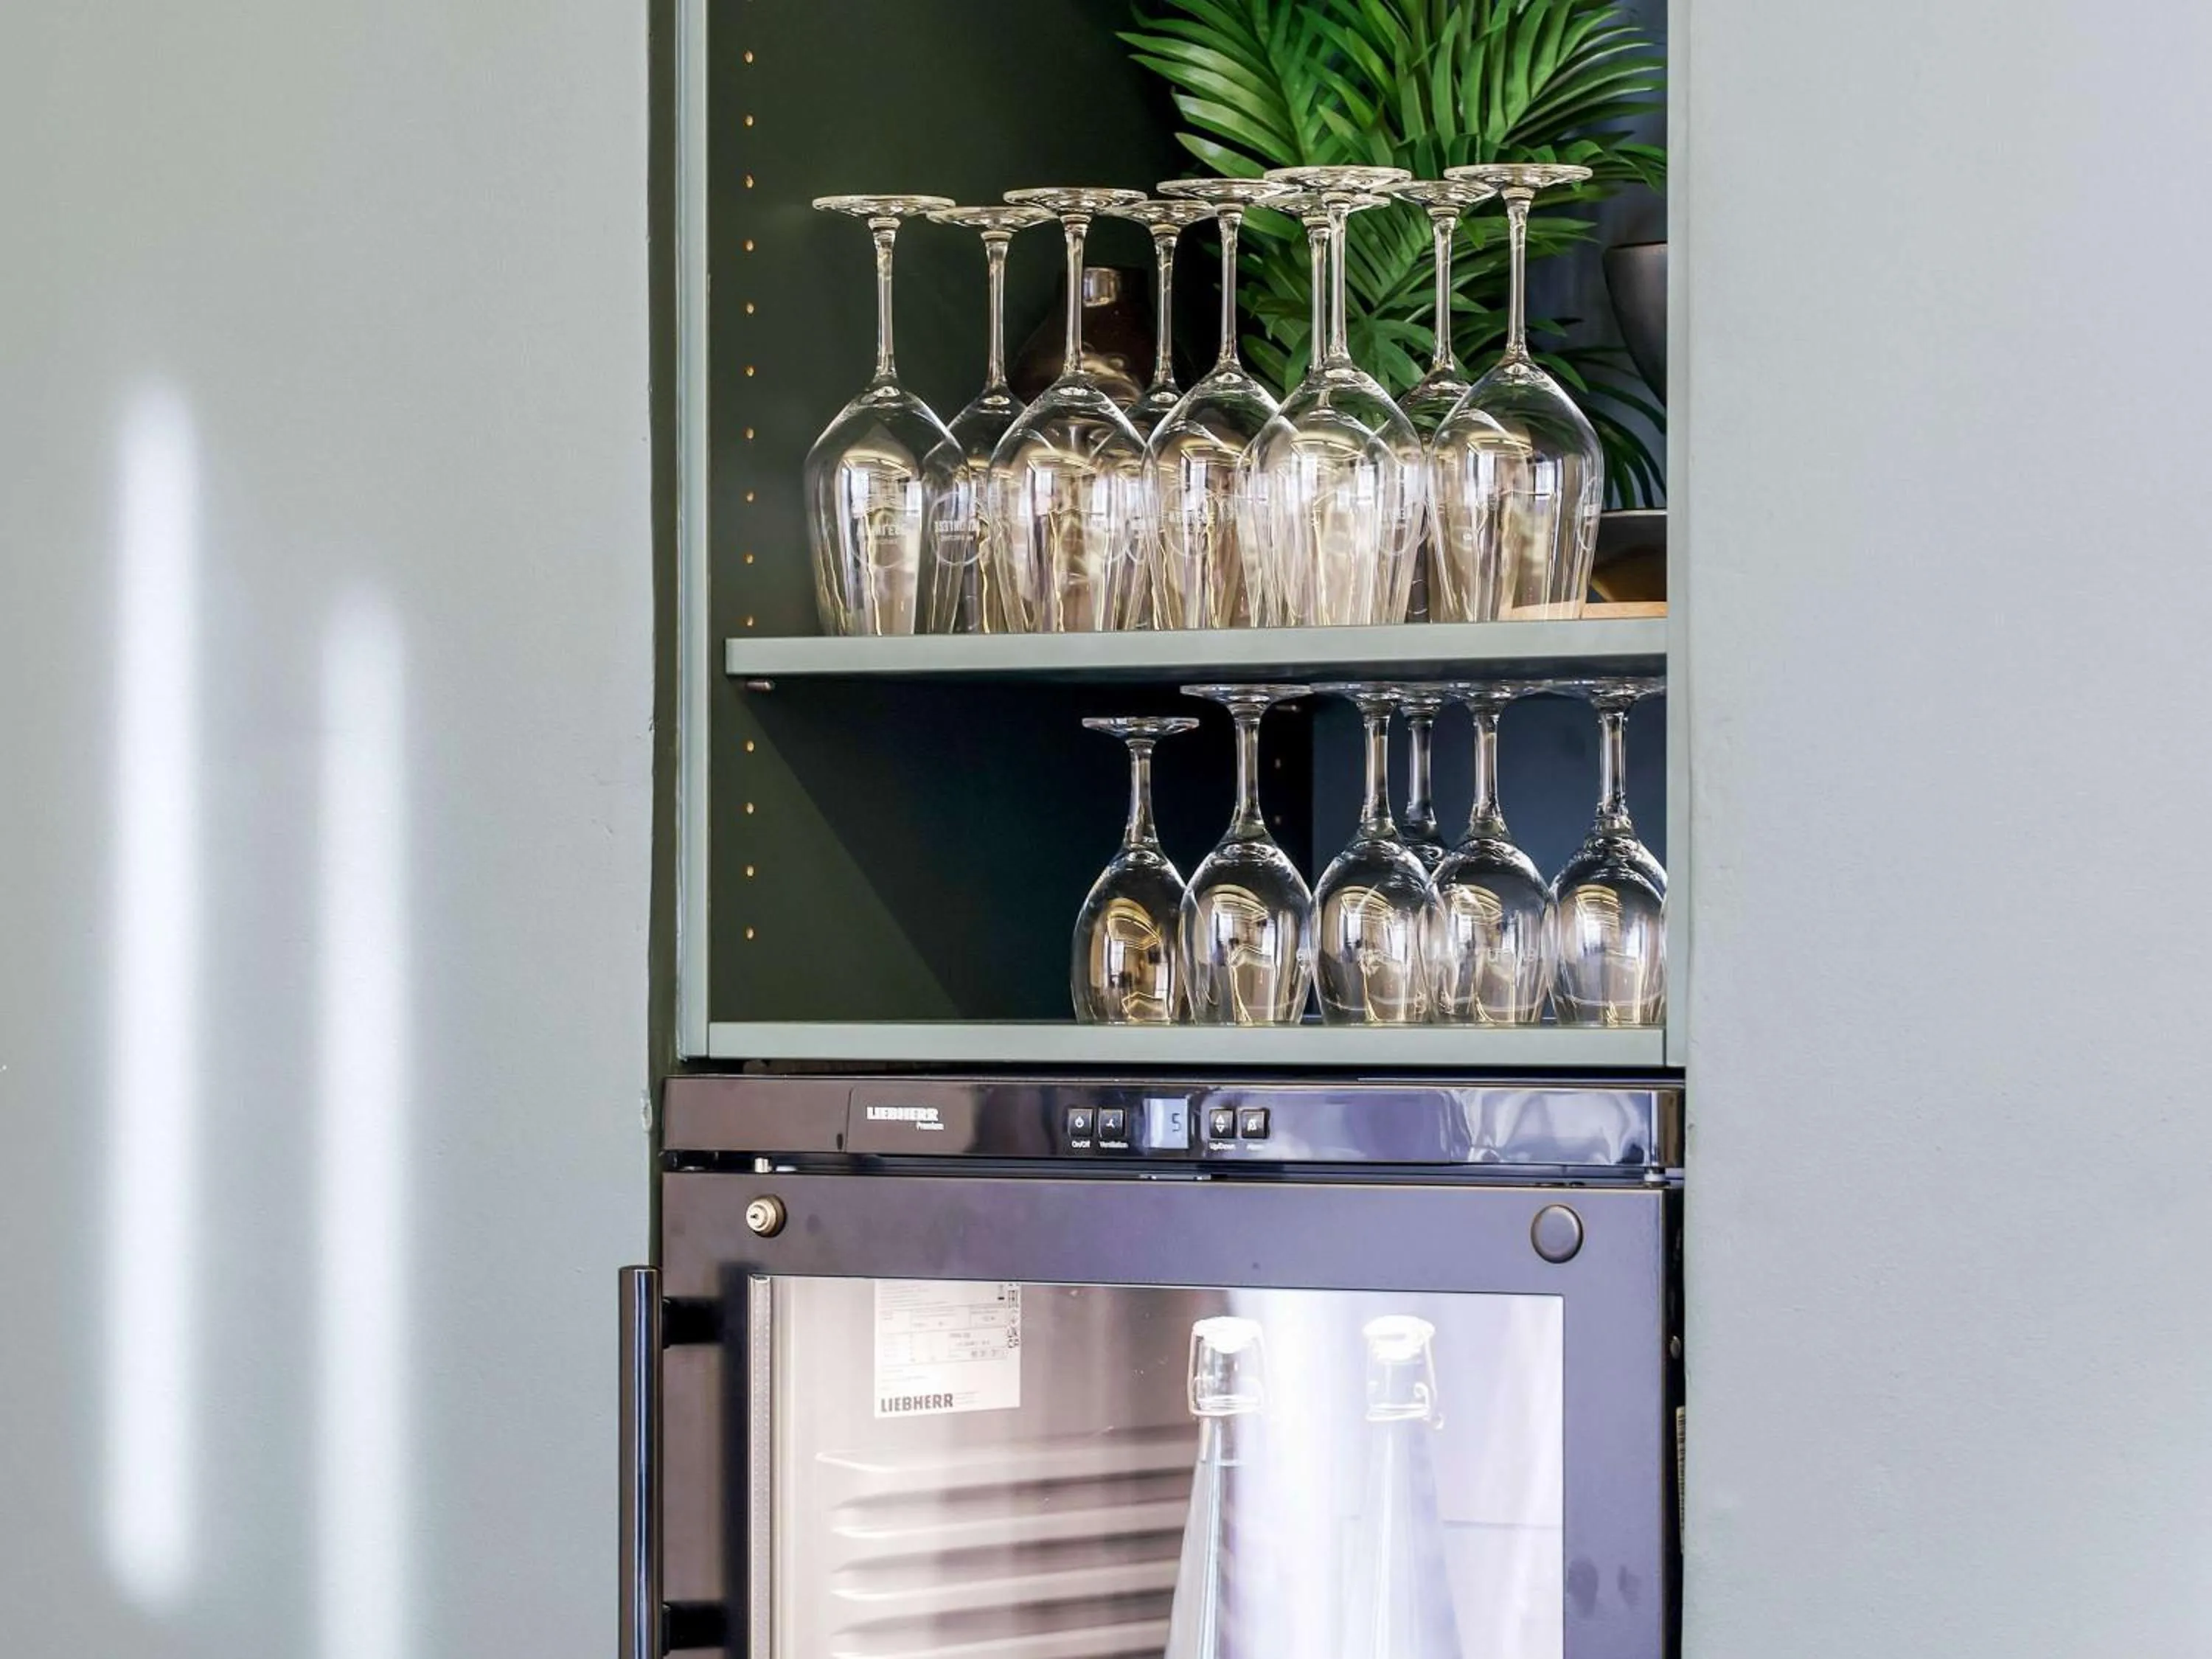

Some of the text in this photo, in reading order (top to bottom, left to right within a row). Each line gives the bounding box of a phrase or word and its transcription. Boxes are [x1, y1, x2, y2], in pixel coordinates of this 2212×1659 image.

[866, 1107, 939, 1121] LIEBHERR
[1171, 1112, 1181, 1133] 5
[880, 1393, 953, 1413] LIEBHERR
